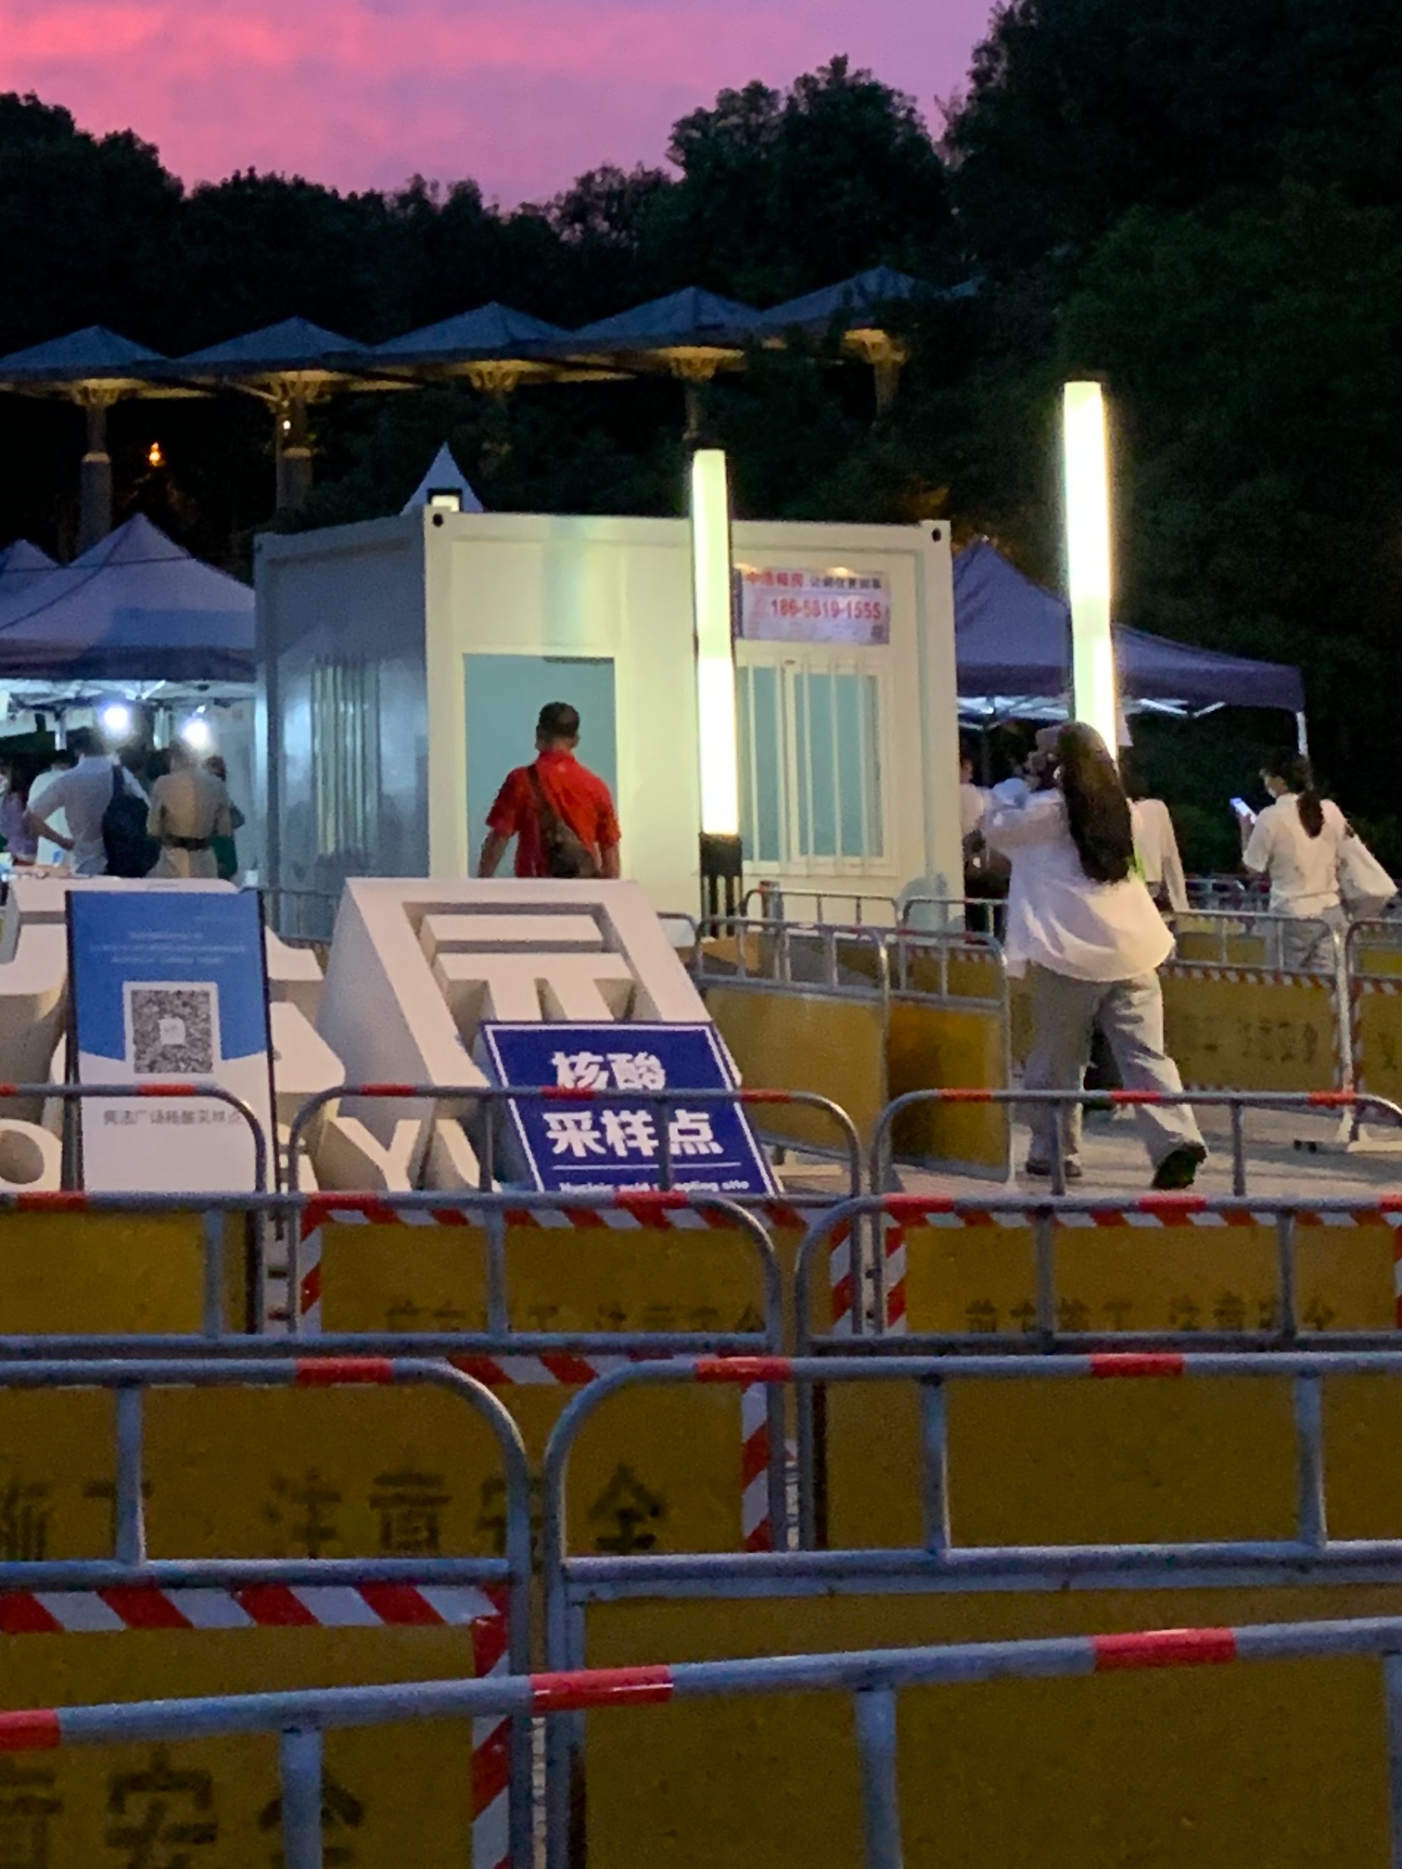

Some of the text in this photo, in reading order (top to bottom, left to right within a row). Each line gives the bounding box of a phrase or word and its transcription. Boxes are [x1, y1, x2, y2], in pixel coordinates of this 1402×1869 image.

[771, 598, 882, 621] 186-5819-1555
[551, 1051, 666, 1090] 核酸
[543, 1109, 724, 1158] 采样点
